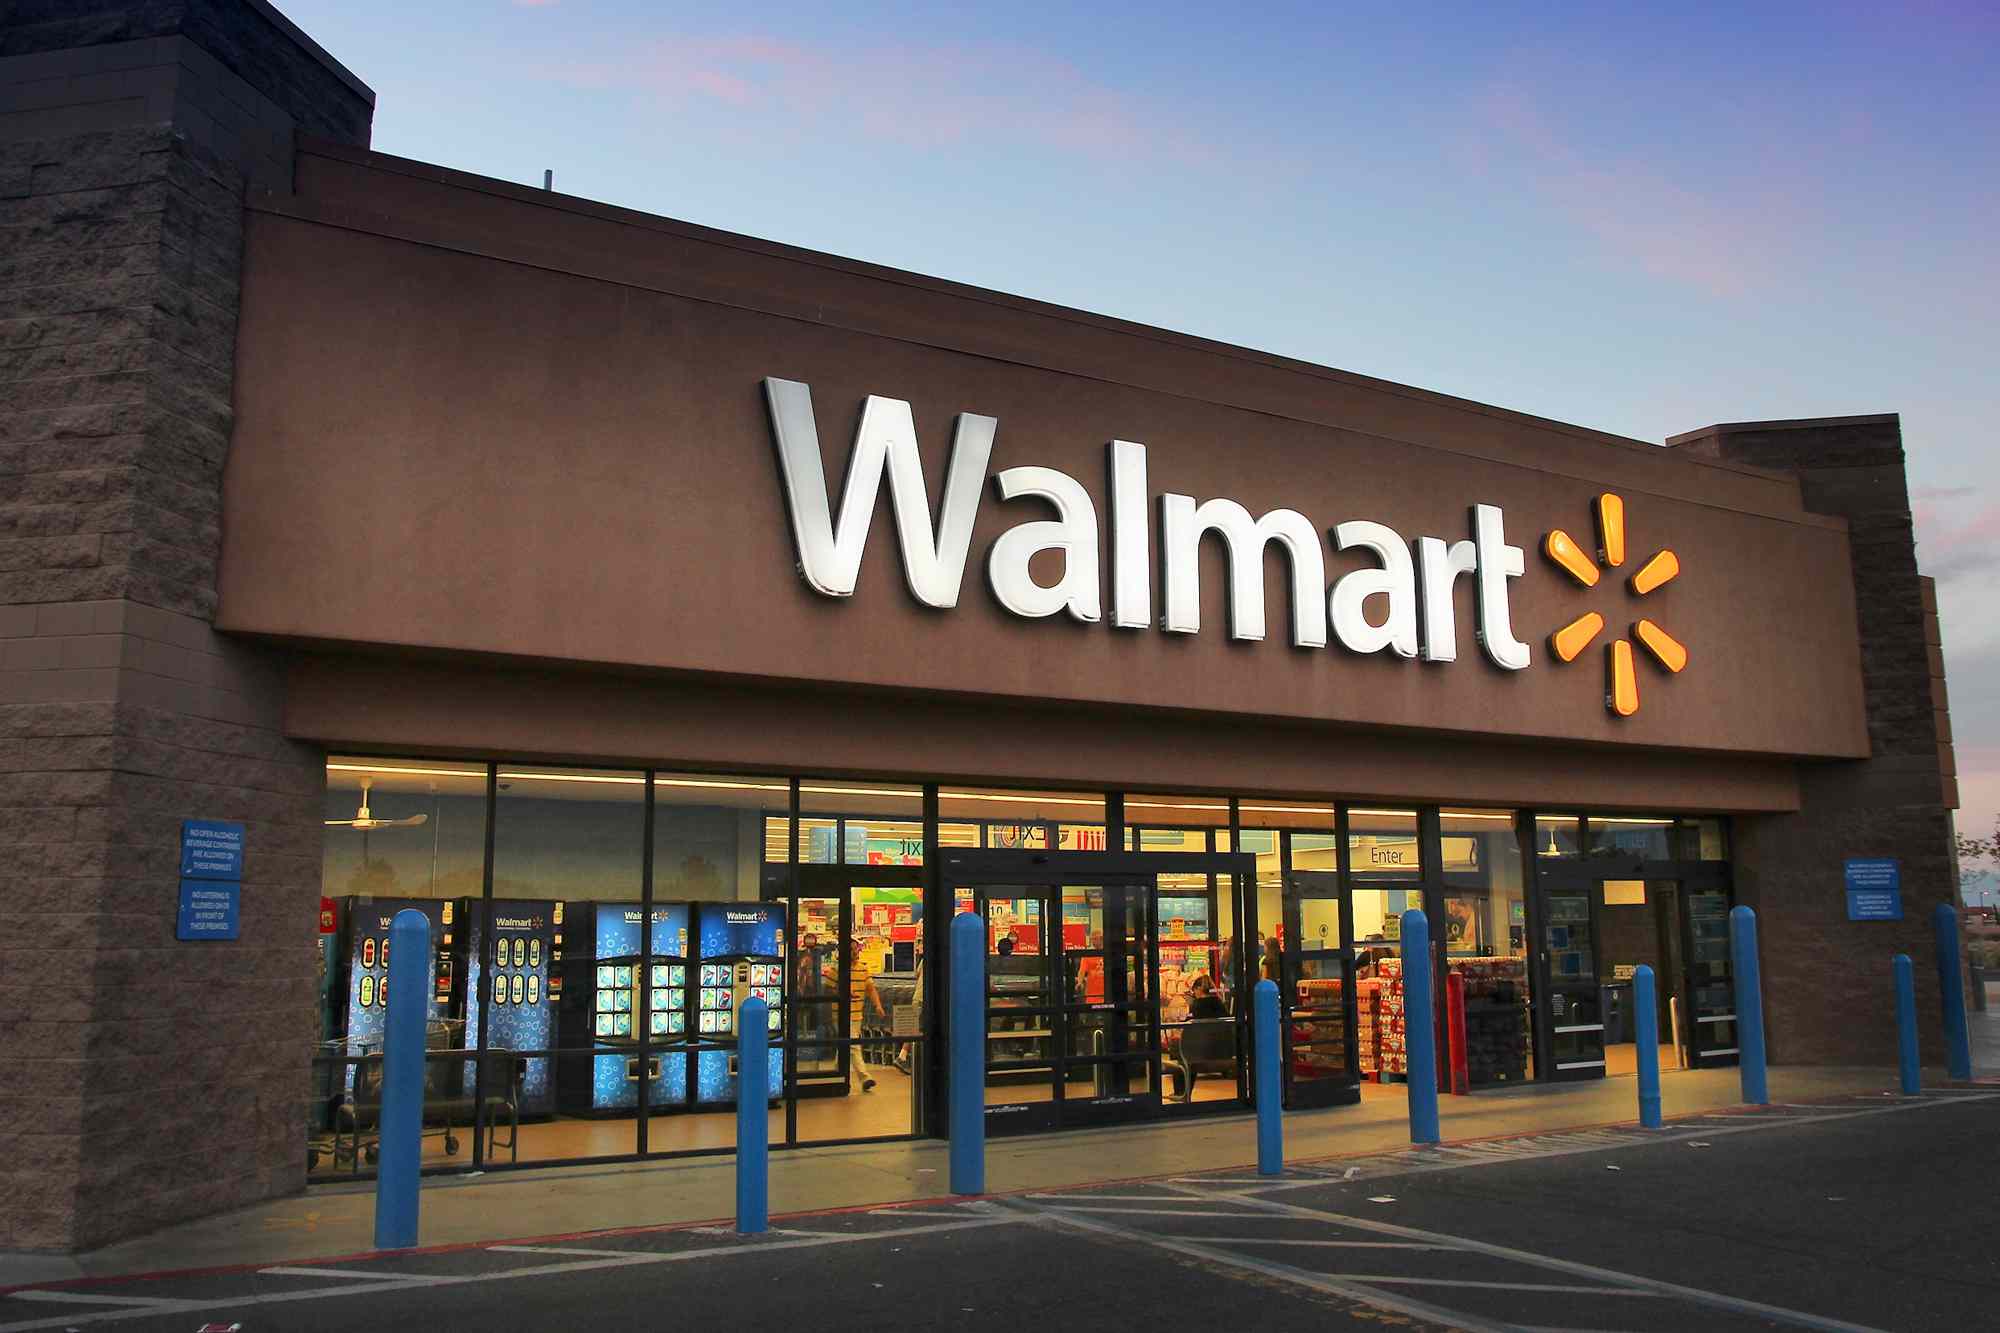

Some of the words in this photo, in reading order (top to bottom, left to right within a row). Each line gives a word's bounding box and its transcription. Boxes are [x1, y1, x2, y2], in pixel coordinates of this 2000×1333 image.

[764, 376, 1530, 670] Walmart
[1371, 847, 1404, 864] Enter
[496, 917, 532, 927] Walmart
[727, 911, 758, 921] Walmart
